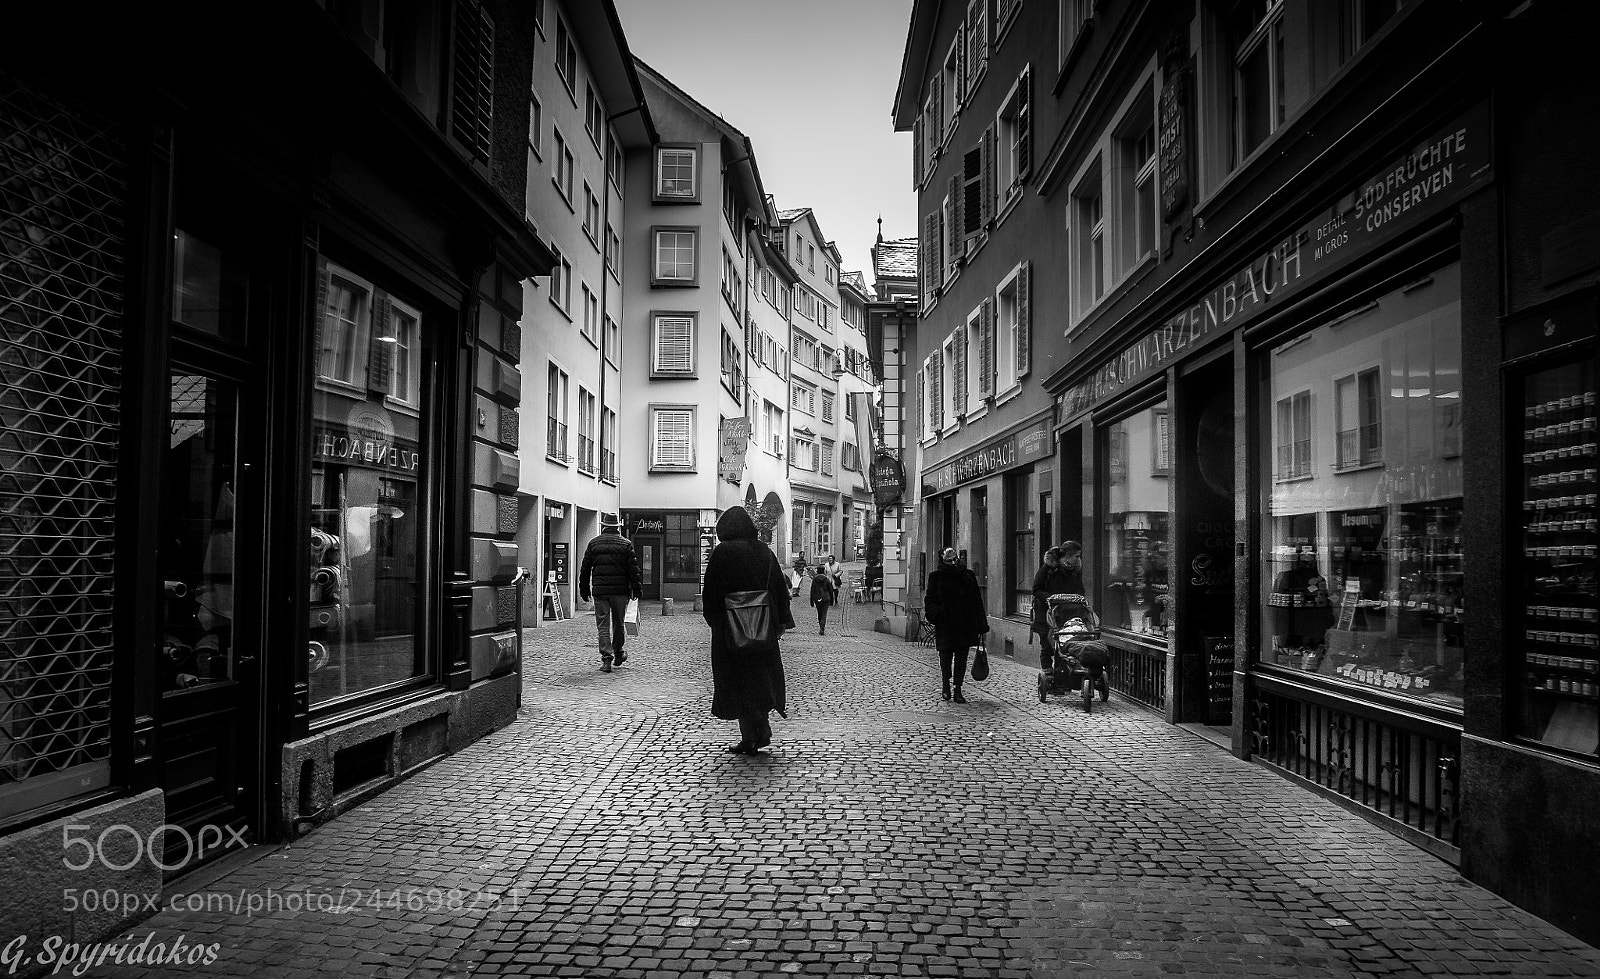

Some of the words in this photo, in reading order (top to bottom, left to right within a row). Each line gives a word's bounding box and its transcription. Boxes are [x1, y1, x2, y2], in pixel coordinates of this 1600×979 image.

[1160, 114, 1181, 156] POST
[1355, 128, 1467, 219] SÜDFRÜCHTE
[1366, 163, 1453, 232] CONSERVEN
[1317, 213, 1347, 240] DETAIL
[1325, 230, 1349, 254] GROS
[1109, 233, 1302, 390] SCHWARZENBACH
[945, 440, 1015, 486] SCHWARZENBACH
